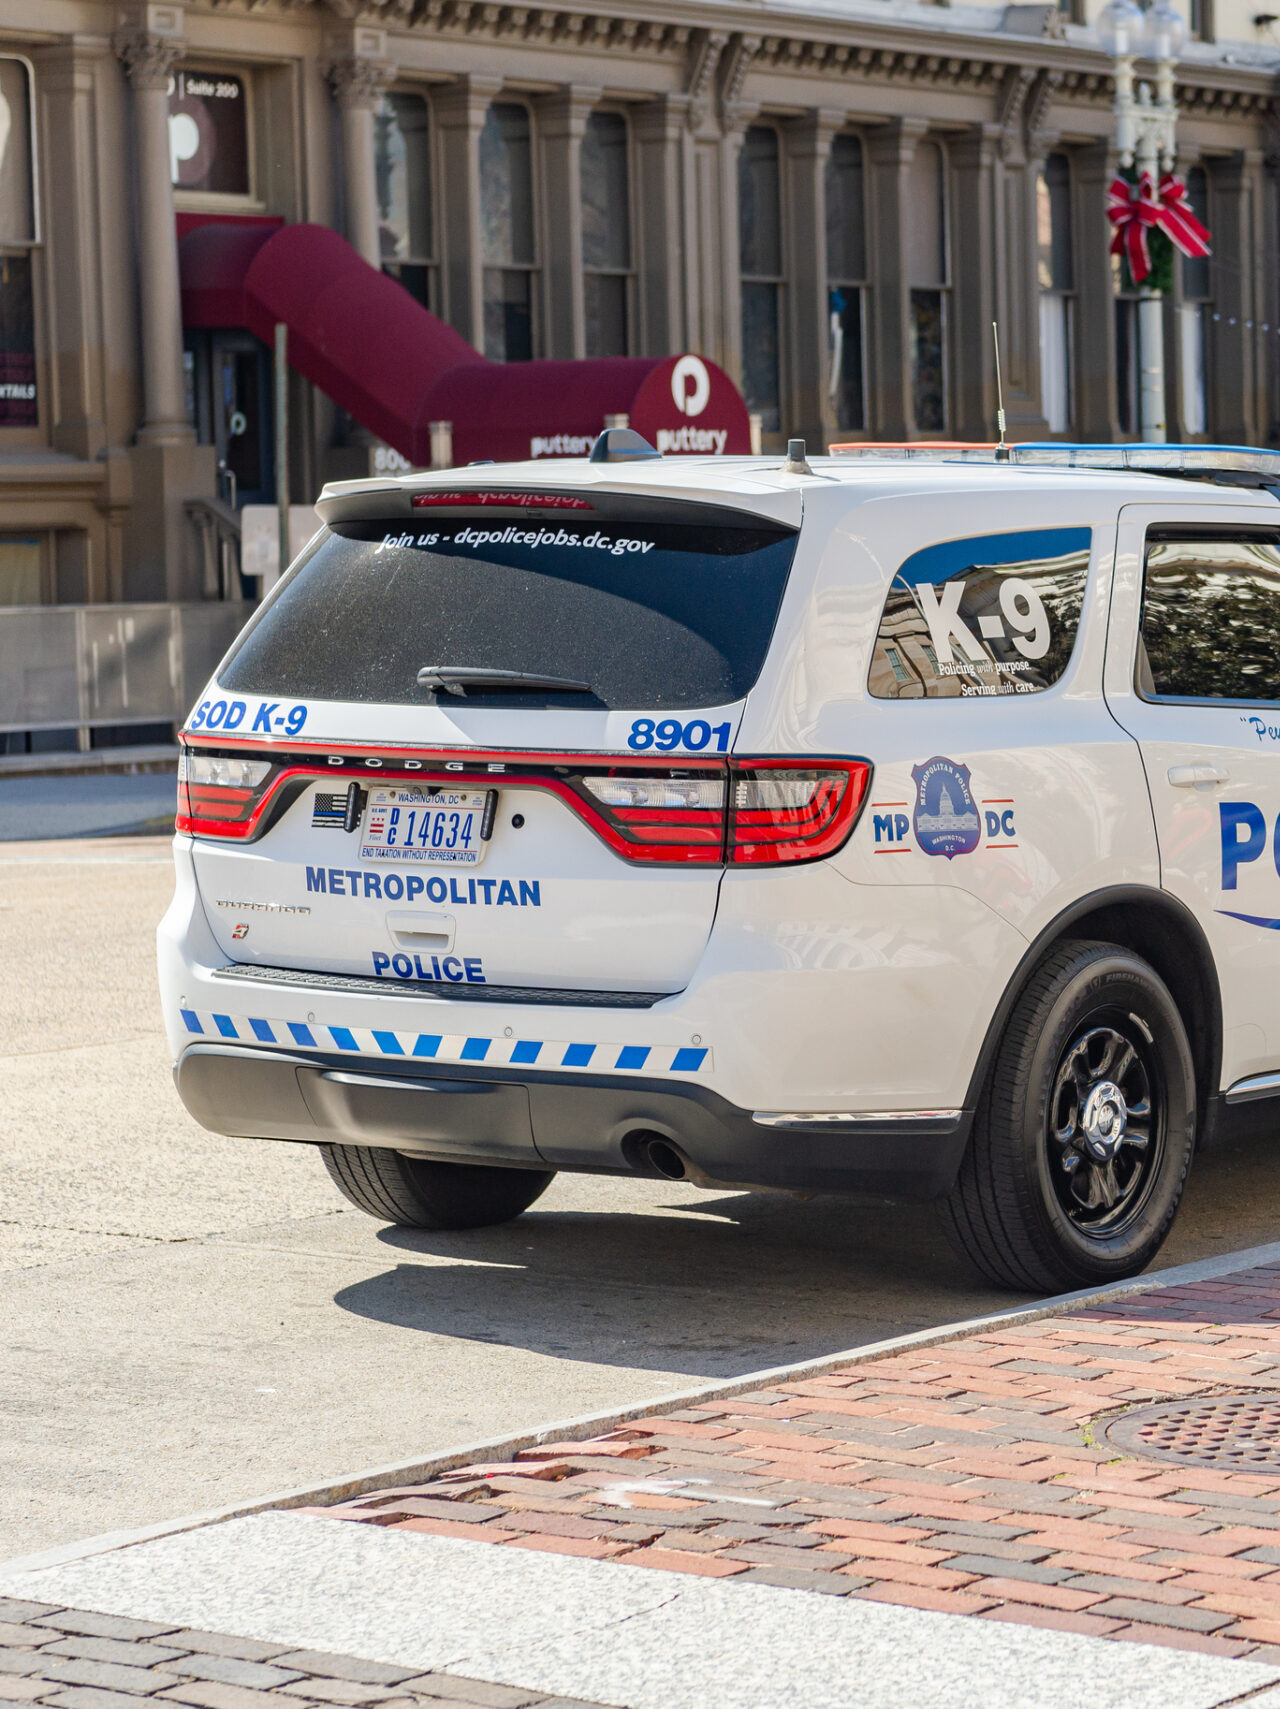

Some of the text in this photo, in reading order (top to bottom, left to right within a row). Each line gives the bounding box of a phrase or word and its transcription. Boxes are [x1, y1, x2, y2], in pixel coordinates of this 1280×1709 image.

[656, 428, 728, 455] puttery
[375, 531, 414, 554] Join
[418, 532, 440, 547] us
[454, 526, 655, 556] dcpolicejobs.dc.gov
[915, 577, 1050, 662] K-9
[938, 662, 975, 676] Policing
[961, 683, 996, 697] Serving
[997, 681, 1014, 693] with
[191, 701, 307, 735] SOD K-9
[627, 719, 732, 752] 8901
[327, 755, 506, 772] DODGE
[448, 795, 459, 804] DC
[954, 772, 970, 805] POLICE
[404, 811, 473, 849] 14634
[873, 813, 910, 842] MP
[986, 810, 1016, 837] DC
[362, 848, 374, 857] END
[402, 850, 427, 860] WITHOUT
[306, 866, 541, 906] METROPOLITAN
[372, 951, 487, 983] POLICE
